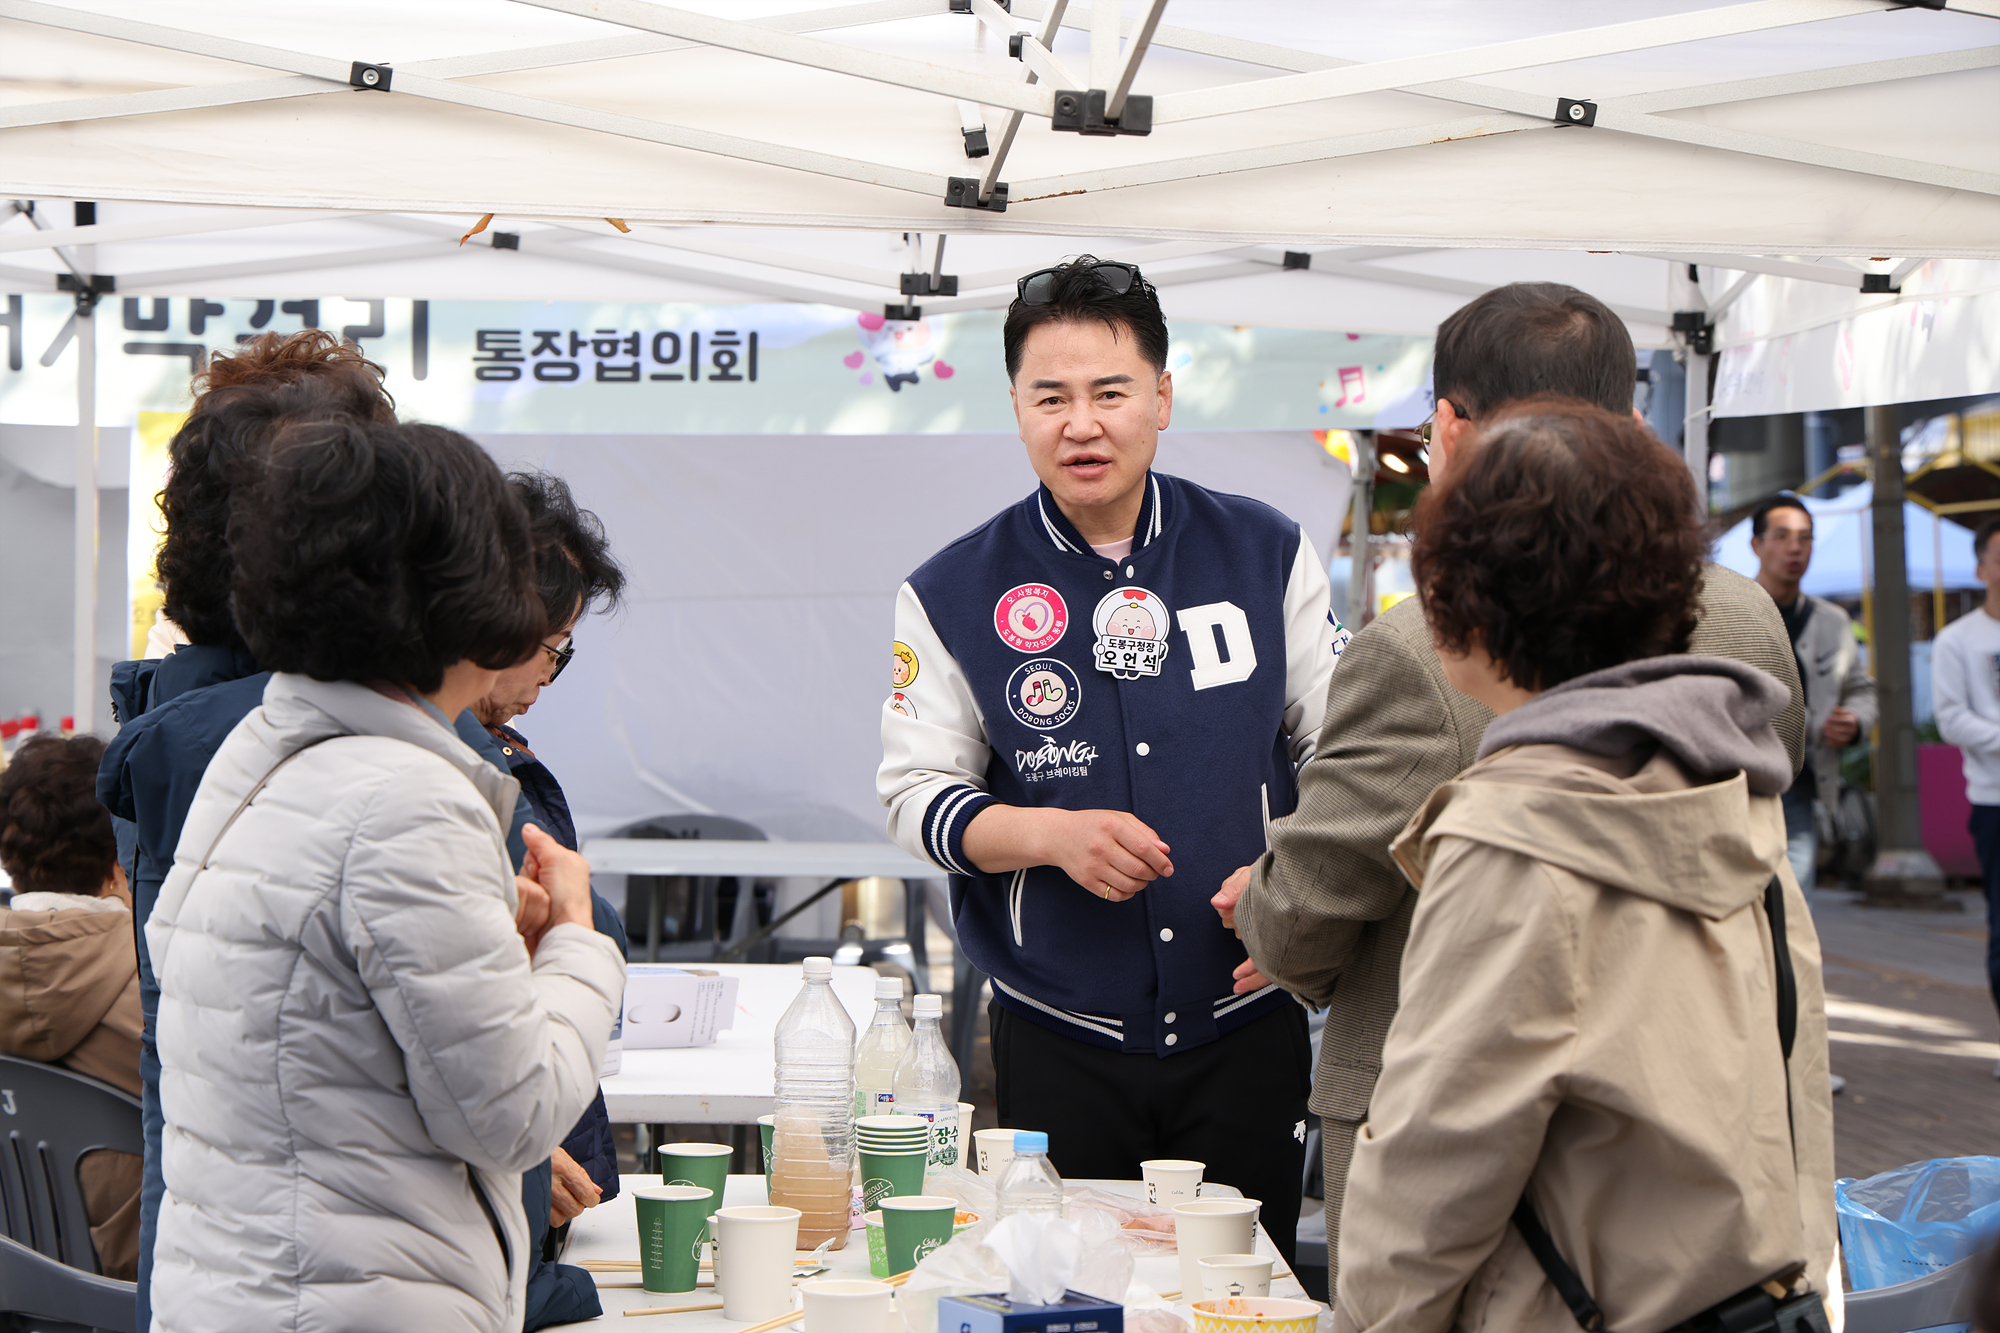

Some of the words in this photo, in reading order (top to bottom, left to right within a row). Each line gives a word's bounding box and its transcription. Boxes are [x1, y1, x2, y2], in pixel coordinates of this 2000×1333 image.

[472, 329, 758, 382] 통장협의회
[1002, 628, 1023, 646] 도봉형
[1024, 634, 1055, 649] 약자와의
[1051, 620, 1064, 635] 동행
[1108, 639, 1155, 653] 도봉구청장
[1176, 601, 1257, 691] D
[1024, 663, 1053, 675] SEOUL
[1017, 707, 1053, 726] DOBONG
[1054, 700, 1076, 723] SOCKS
[1025, 771, 1044, 782] 도봉구
[1046, 766, 1088, 779] 브레이킹팀
